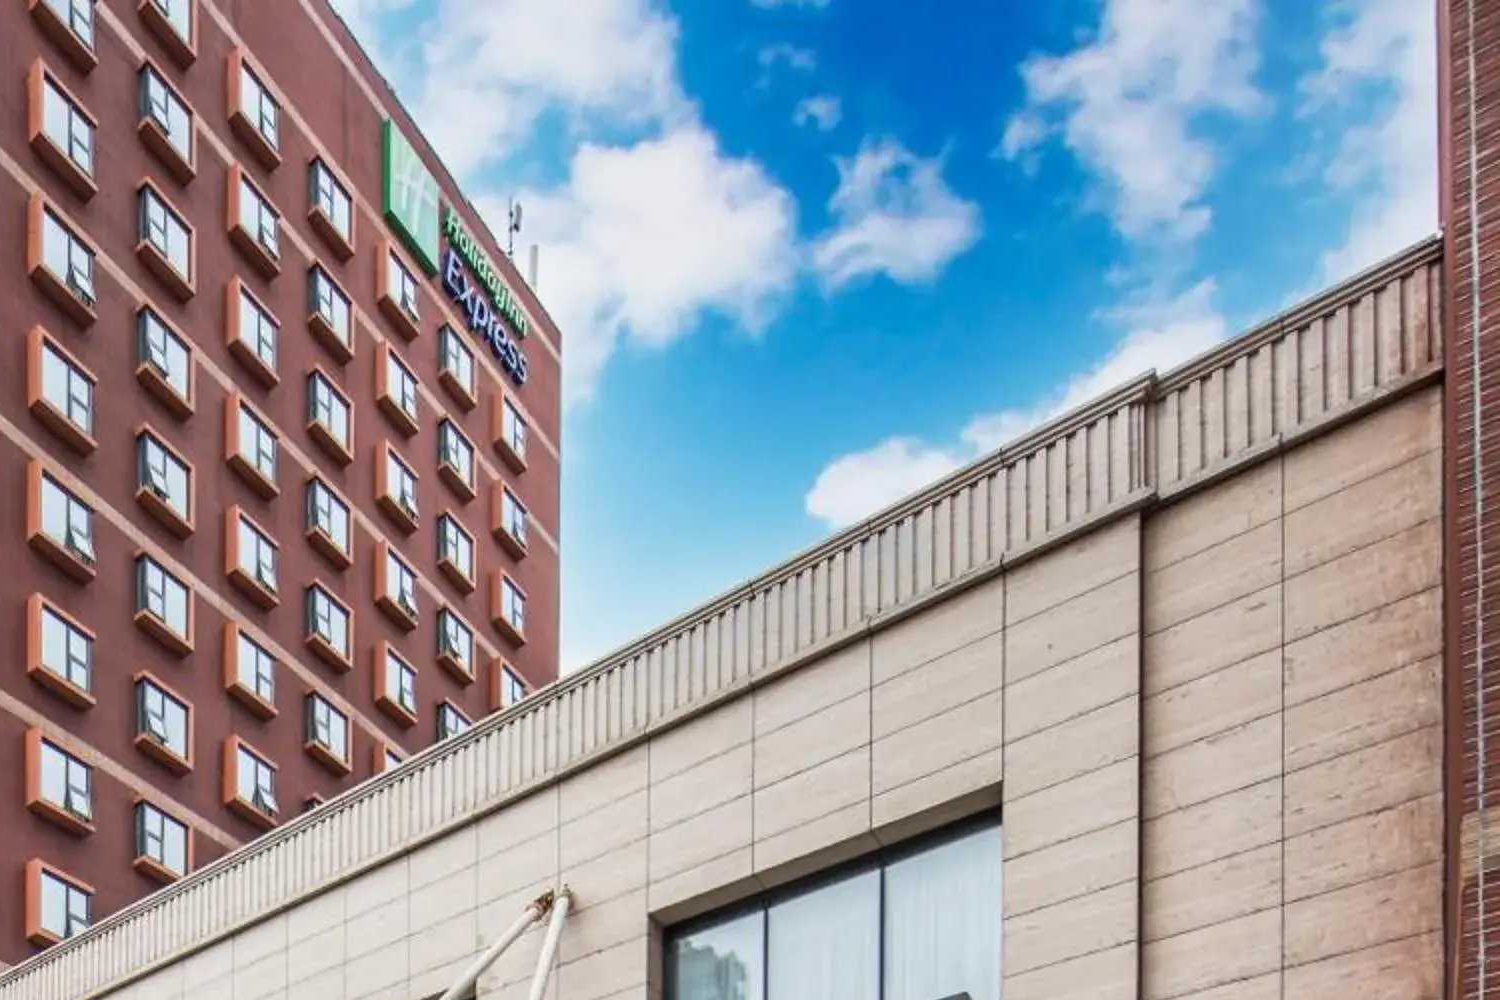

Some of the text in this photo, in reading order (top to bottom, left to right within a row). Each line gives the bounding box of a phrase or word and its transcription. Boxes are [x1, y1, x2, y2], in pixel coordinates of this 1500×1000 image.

[443, 250, 529, 386] Express
[445, 206, 530, 338] Holiday Inn
